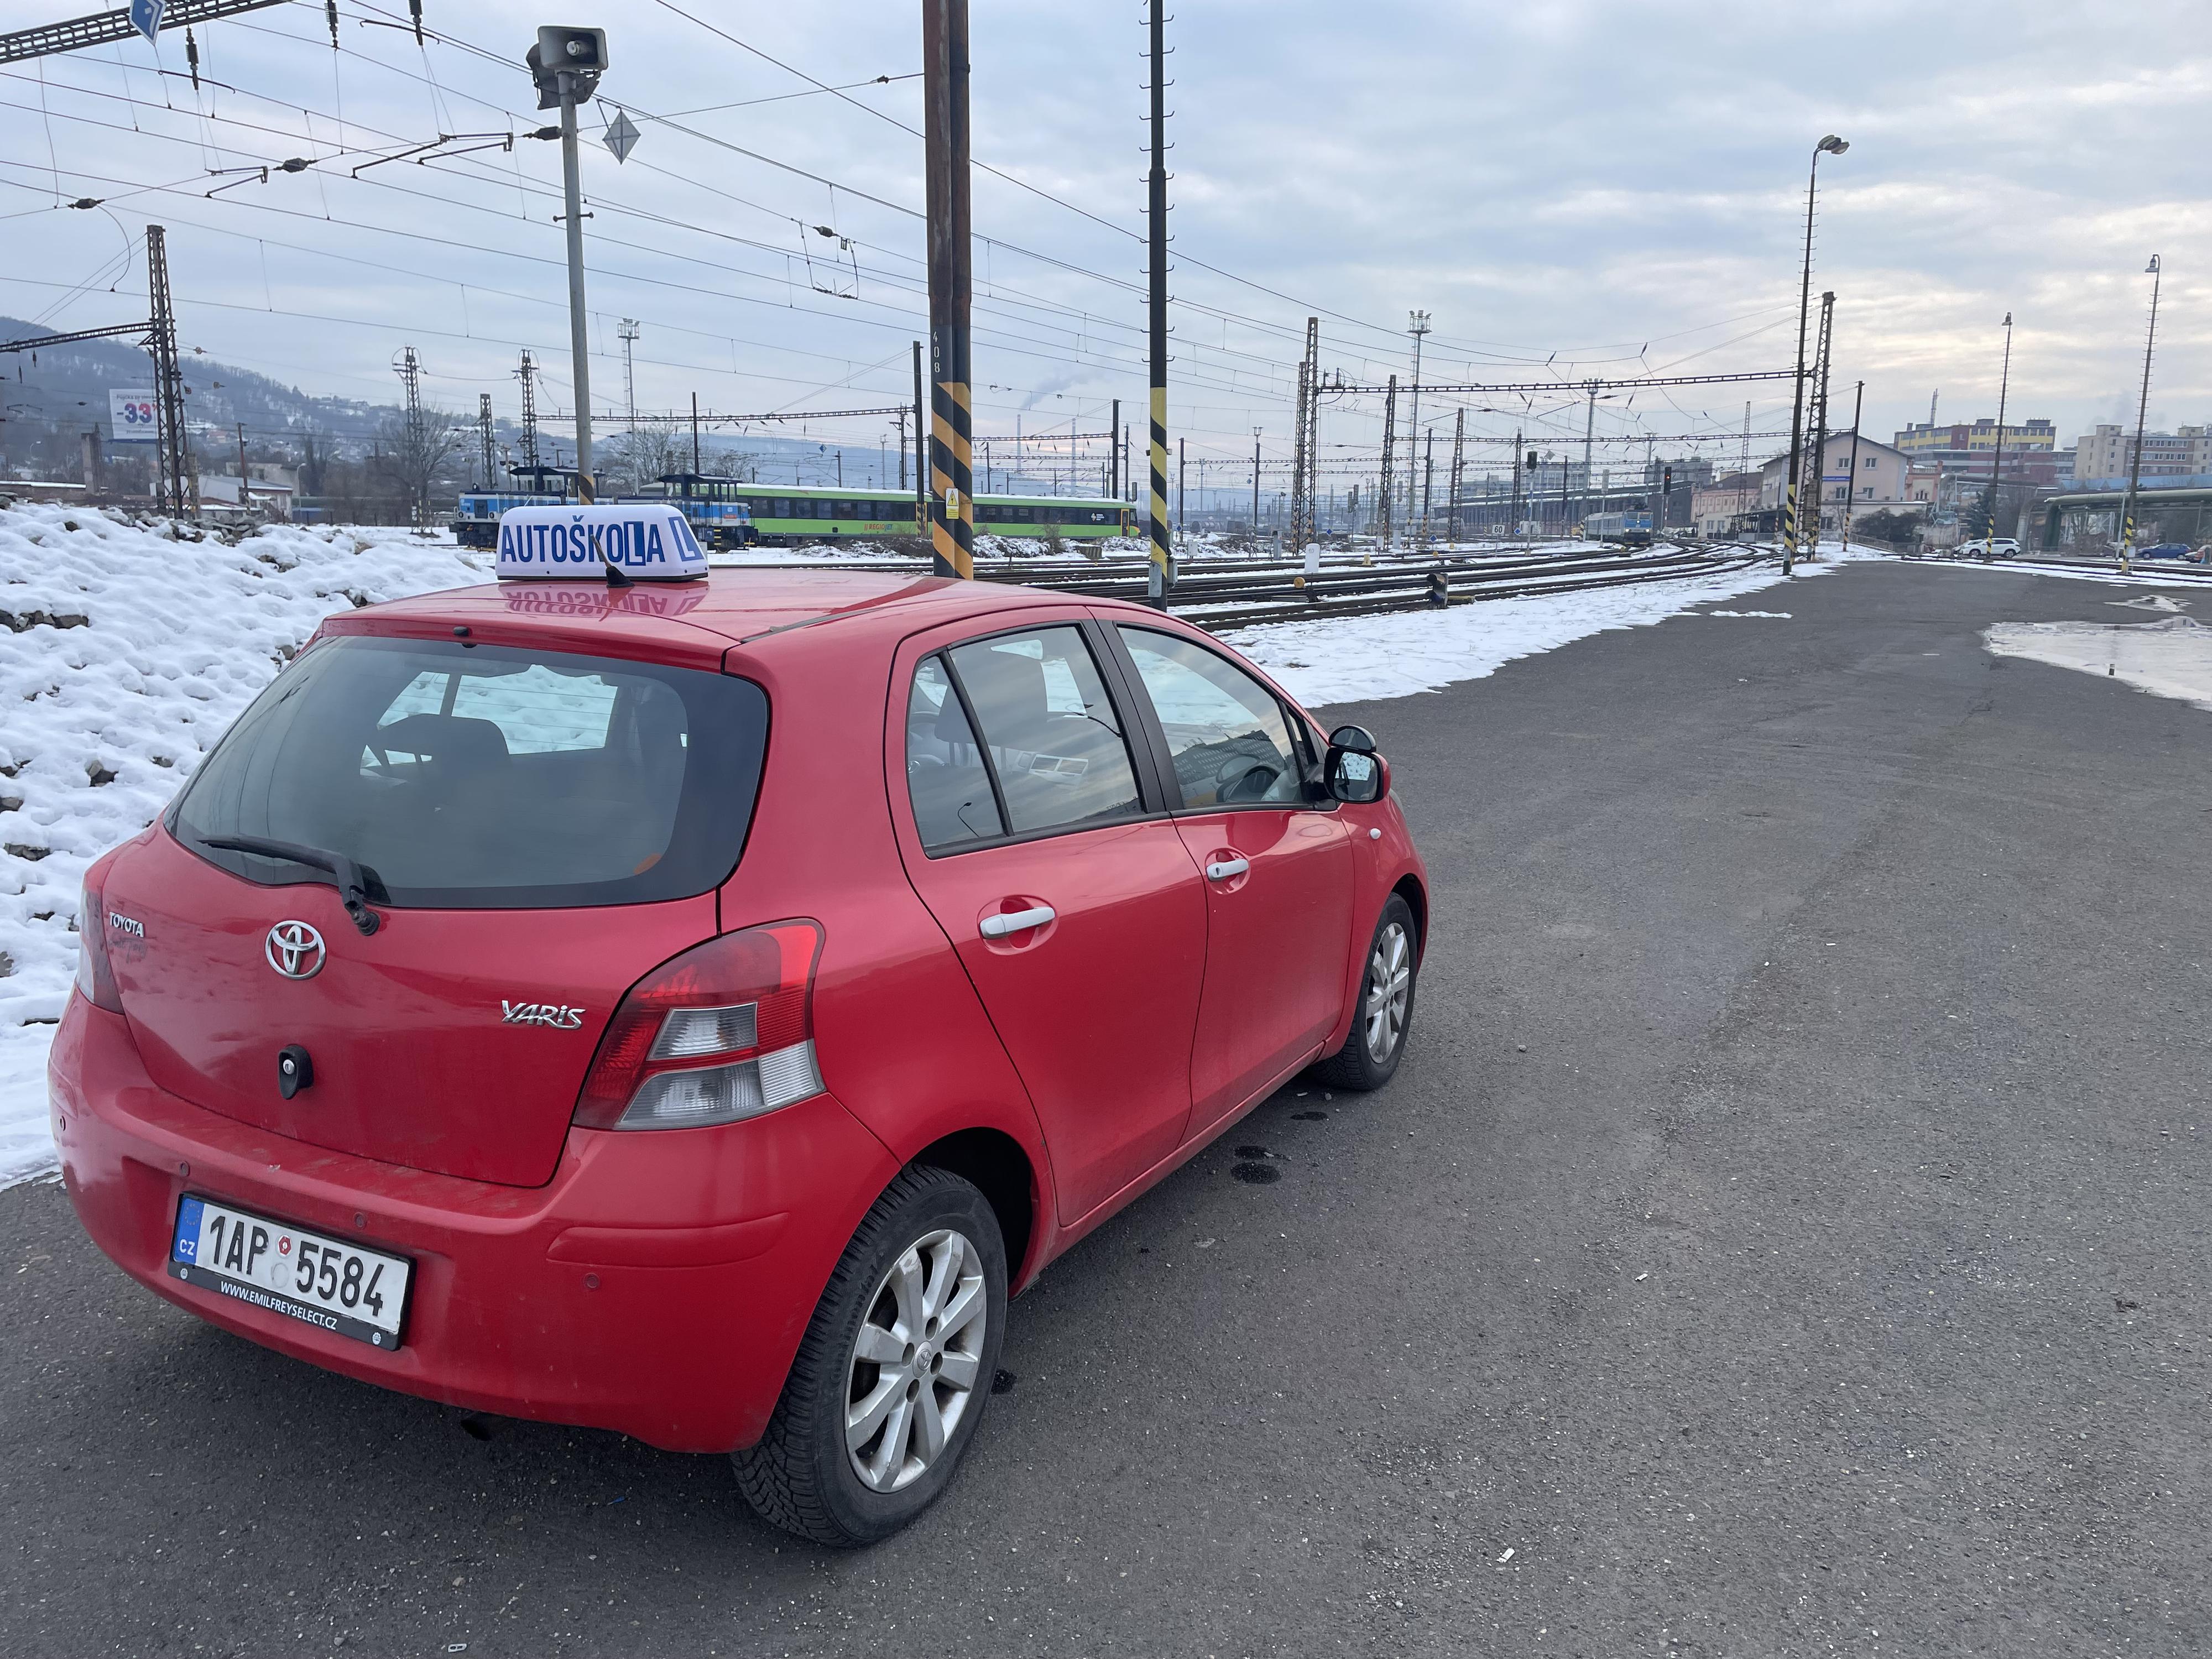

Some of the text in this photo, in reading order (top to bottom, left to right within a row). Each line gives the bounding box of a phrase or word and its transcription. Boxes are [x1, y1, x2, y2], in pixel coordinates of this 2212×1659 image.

[501, 515, 666, 566] AUTOŠKOLA
[670, 518, 701, 560] L
[109, 911, 144, 938] TOYOTA
[180, 1239, 195, 1256] CZ
[210, 1215, 384, 1317] 1AP 5584
[221, 1281, 338, 1331] WWW.EMILFREYSELECT.CZ
